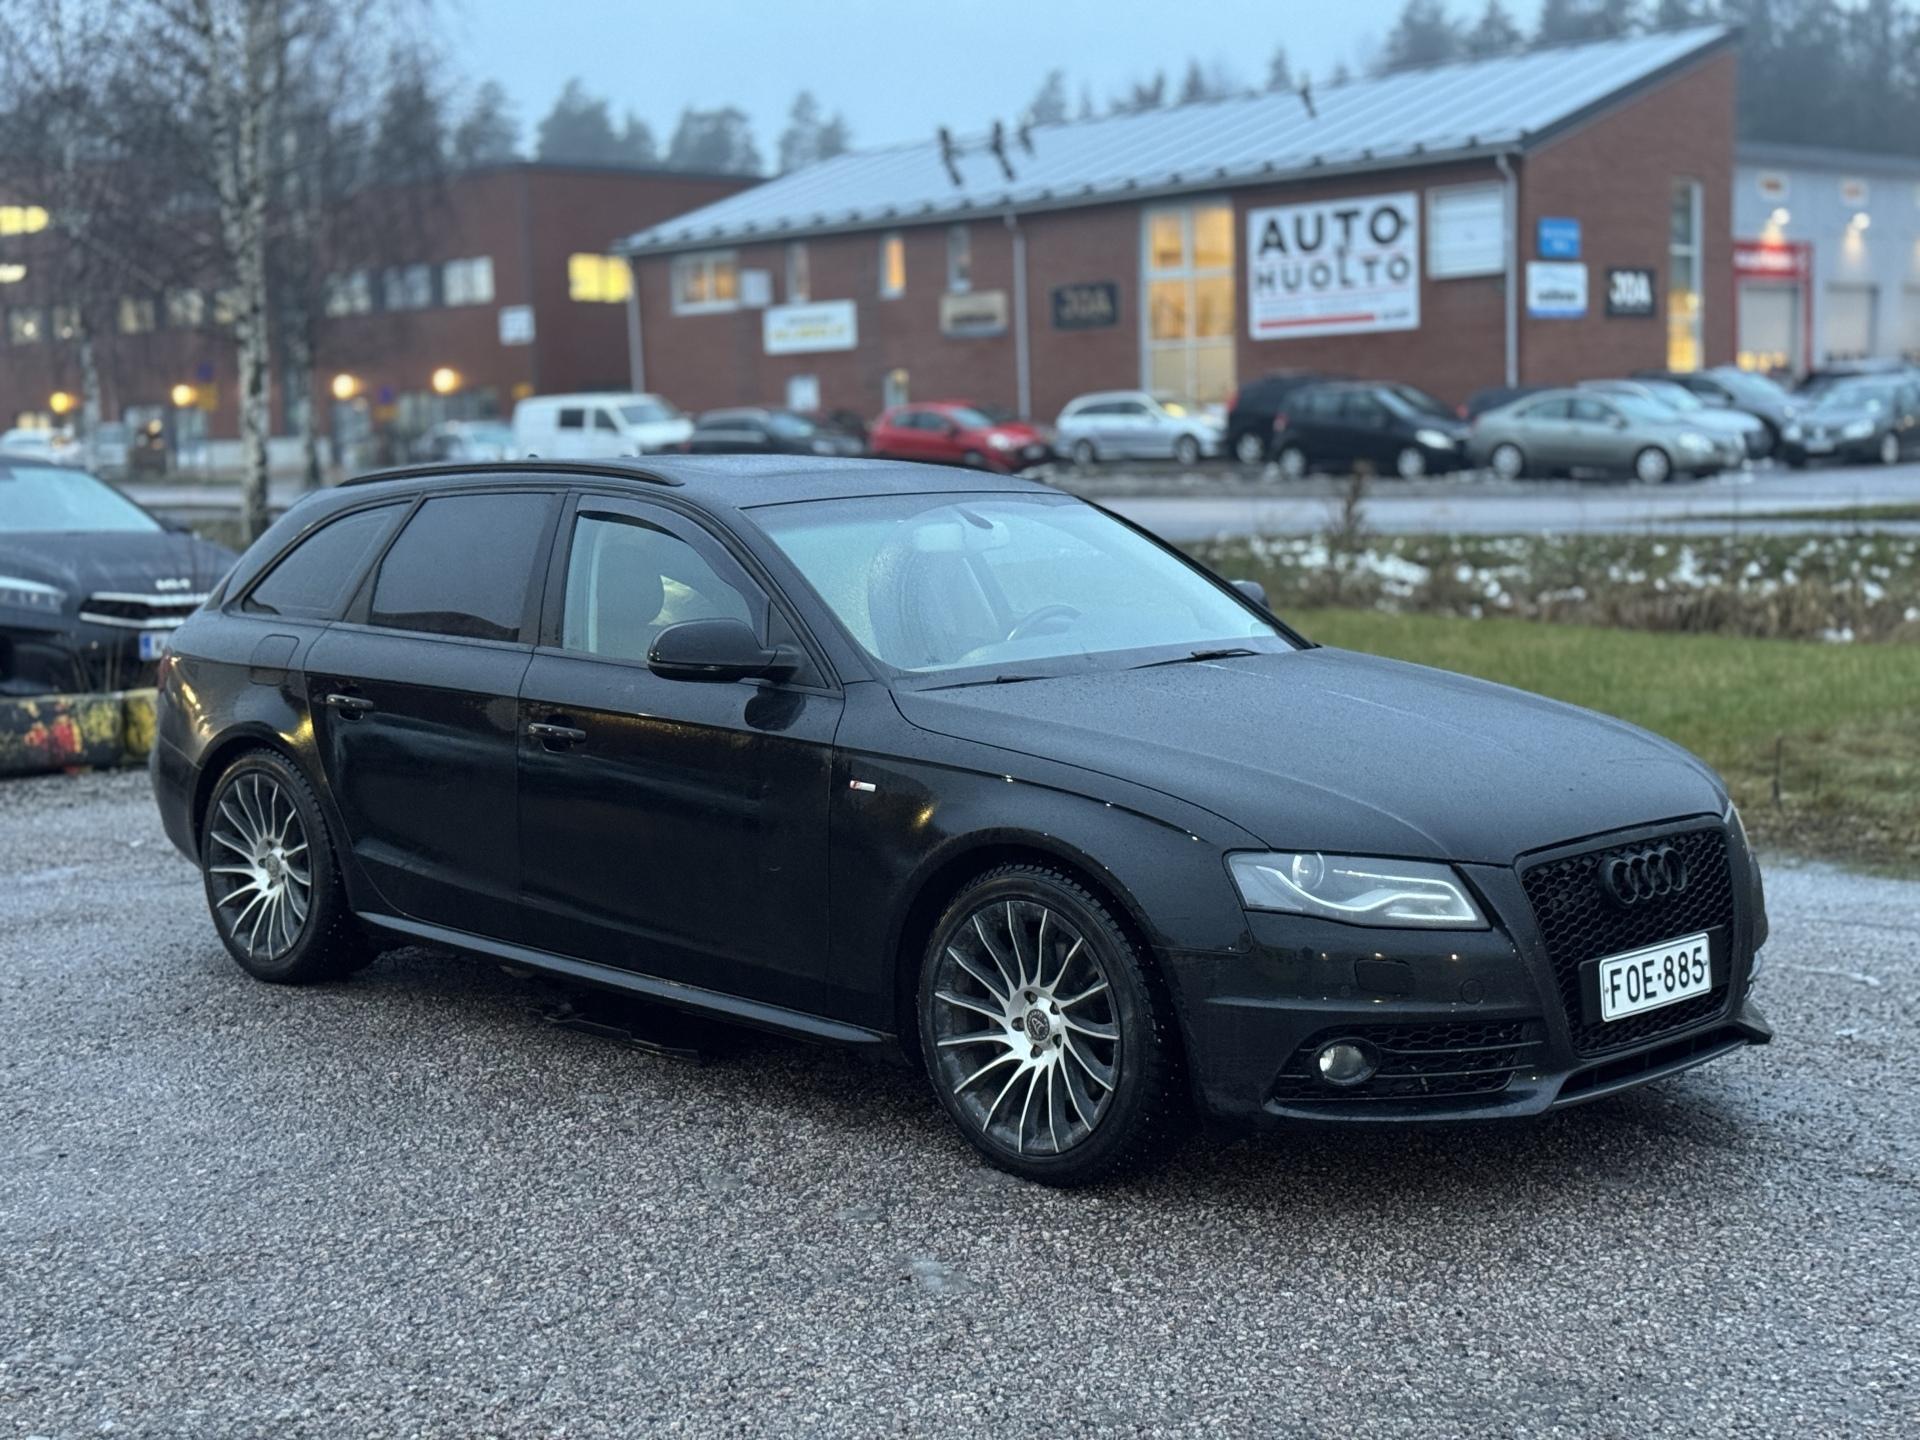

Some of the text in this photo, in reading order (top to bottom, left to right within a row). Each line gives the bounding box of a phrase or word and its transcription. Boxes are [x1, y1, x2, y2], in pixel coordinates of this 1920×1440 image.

[1259, 206, 1407, 255] AUTO
[1257, 252, 1410, 293] HUOLTO
[1610, 946, 1705, 1009] FOE-885
